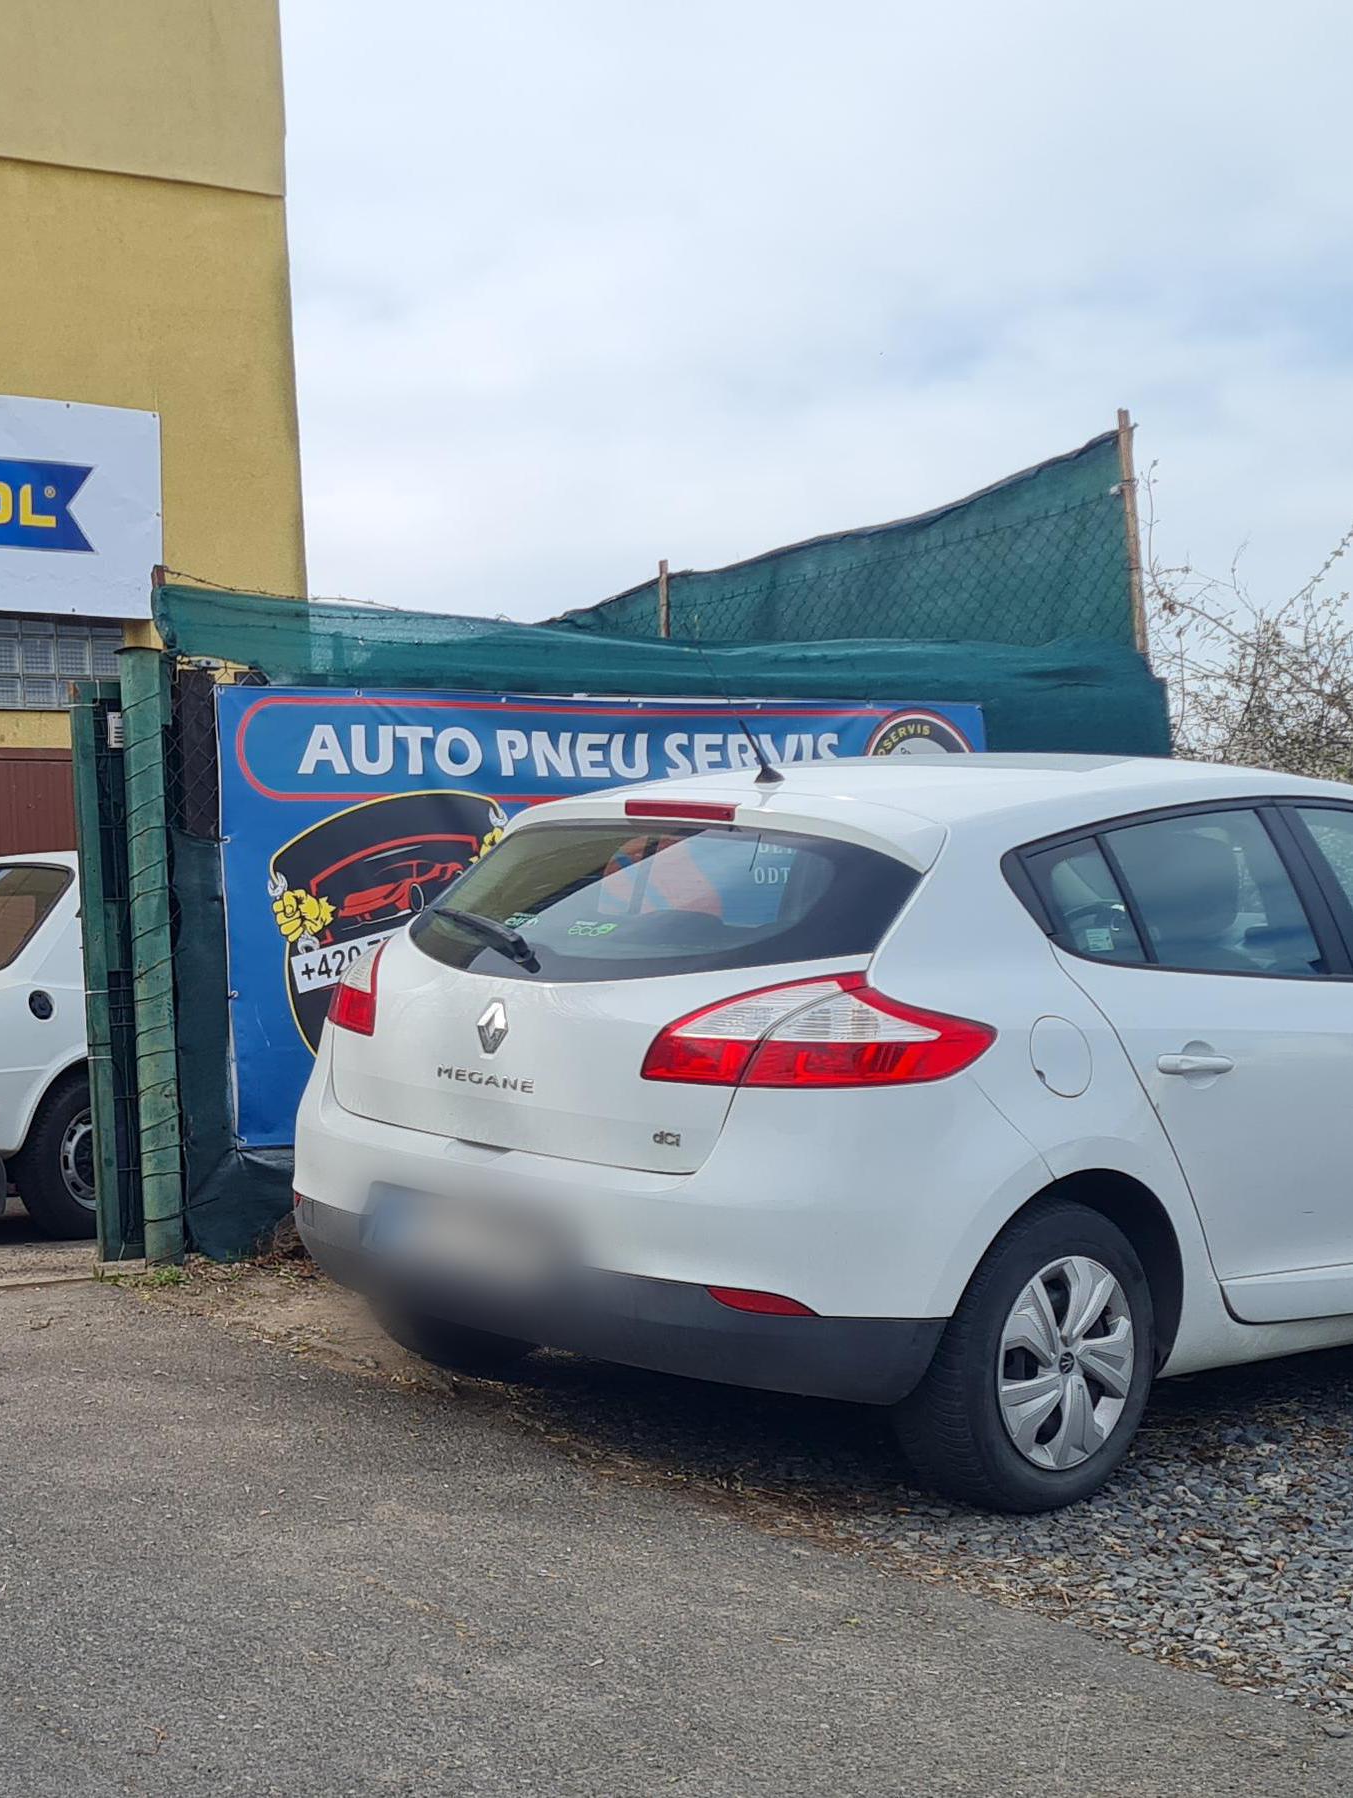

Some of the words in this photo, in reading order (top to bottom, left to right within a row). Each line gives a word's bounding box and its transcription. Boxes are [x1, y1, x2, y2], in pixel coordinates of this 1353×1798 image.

[297, 724, 483, 776] AUTO
[496, 728, 649, 779] PNEU
[664, 732, 839, 779] SERVIS
[437, 1064, 534, 1094] MEGANE
